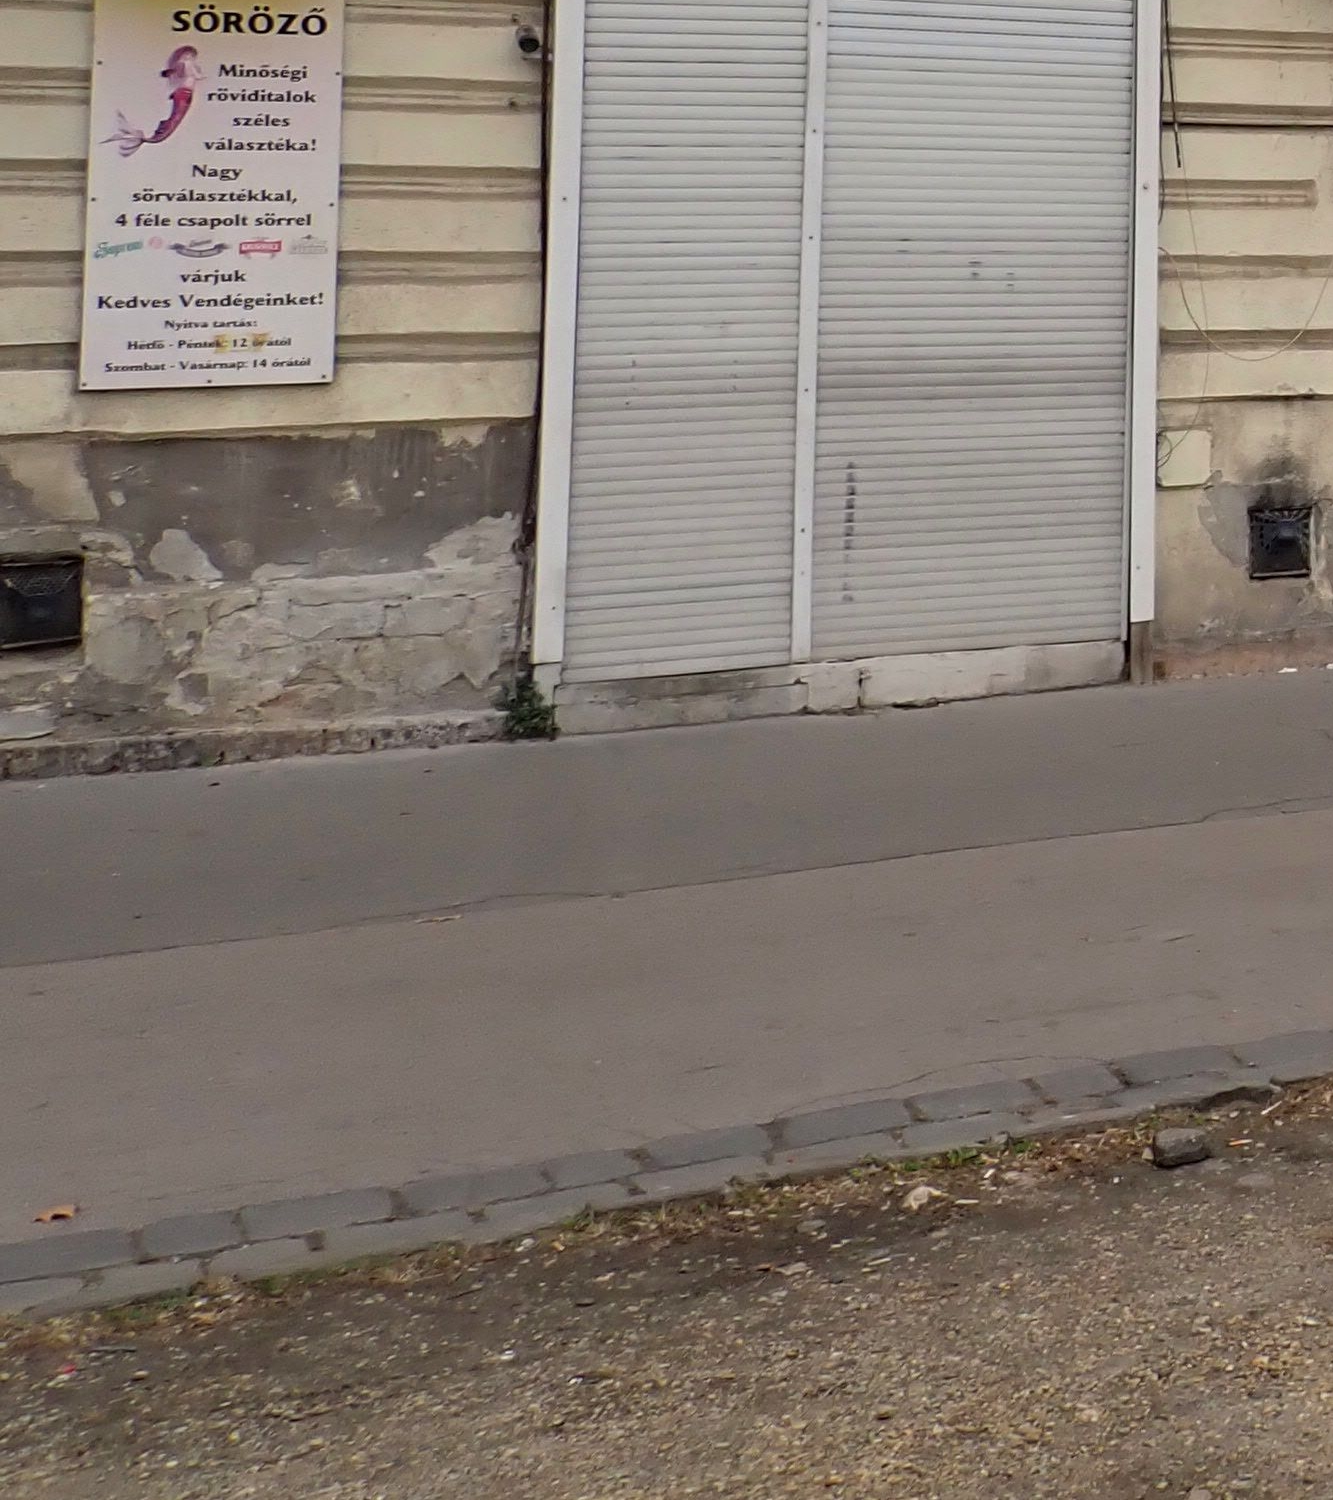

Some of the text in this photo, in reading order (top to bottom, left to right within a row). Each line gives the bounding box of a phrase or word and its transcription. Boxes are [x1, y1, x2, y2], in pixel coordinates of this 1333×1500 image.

[172, 4, 327, 36] SÖRÖZŐ
[232, 112, 290, 128] széles
[204, 137, 317, 153] választéka!
[191, 164, 243, 183] Nagy
[132, 188, 298, 205] sörválasztékkal,
[115, 212, 312, 230] 4 féle csapolt sörrel
[180, 269, 247, 286] várjuk
[97, 293, 324, 312] Kedves Vendégeinket!
[232, 337, 248, 349] 12
[252, 358, 268, 370] 14
